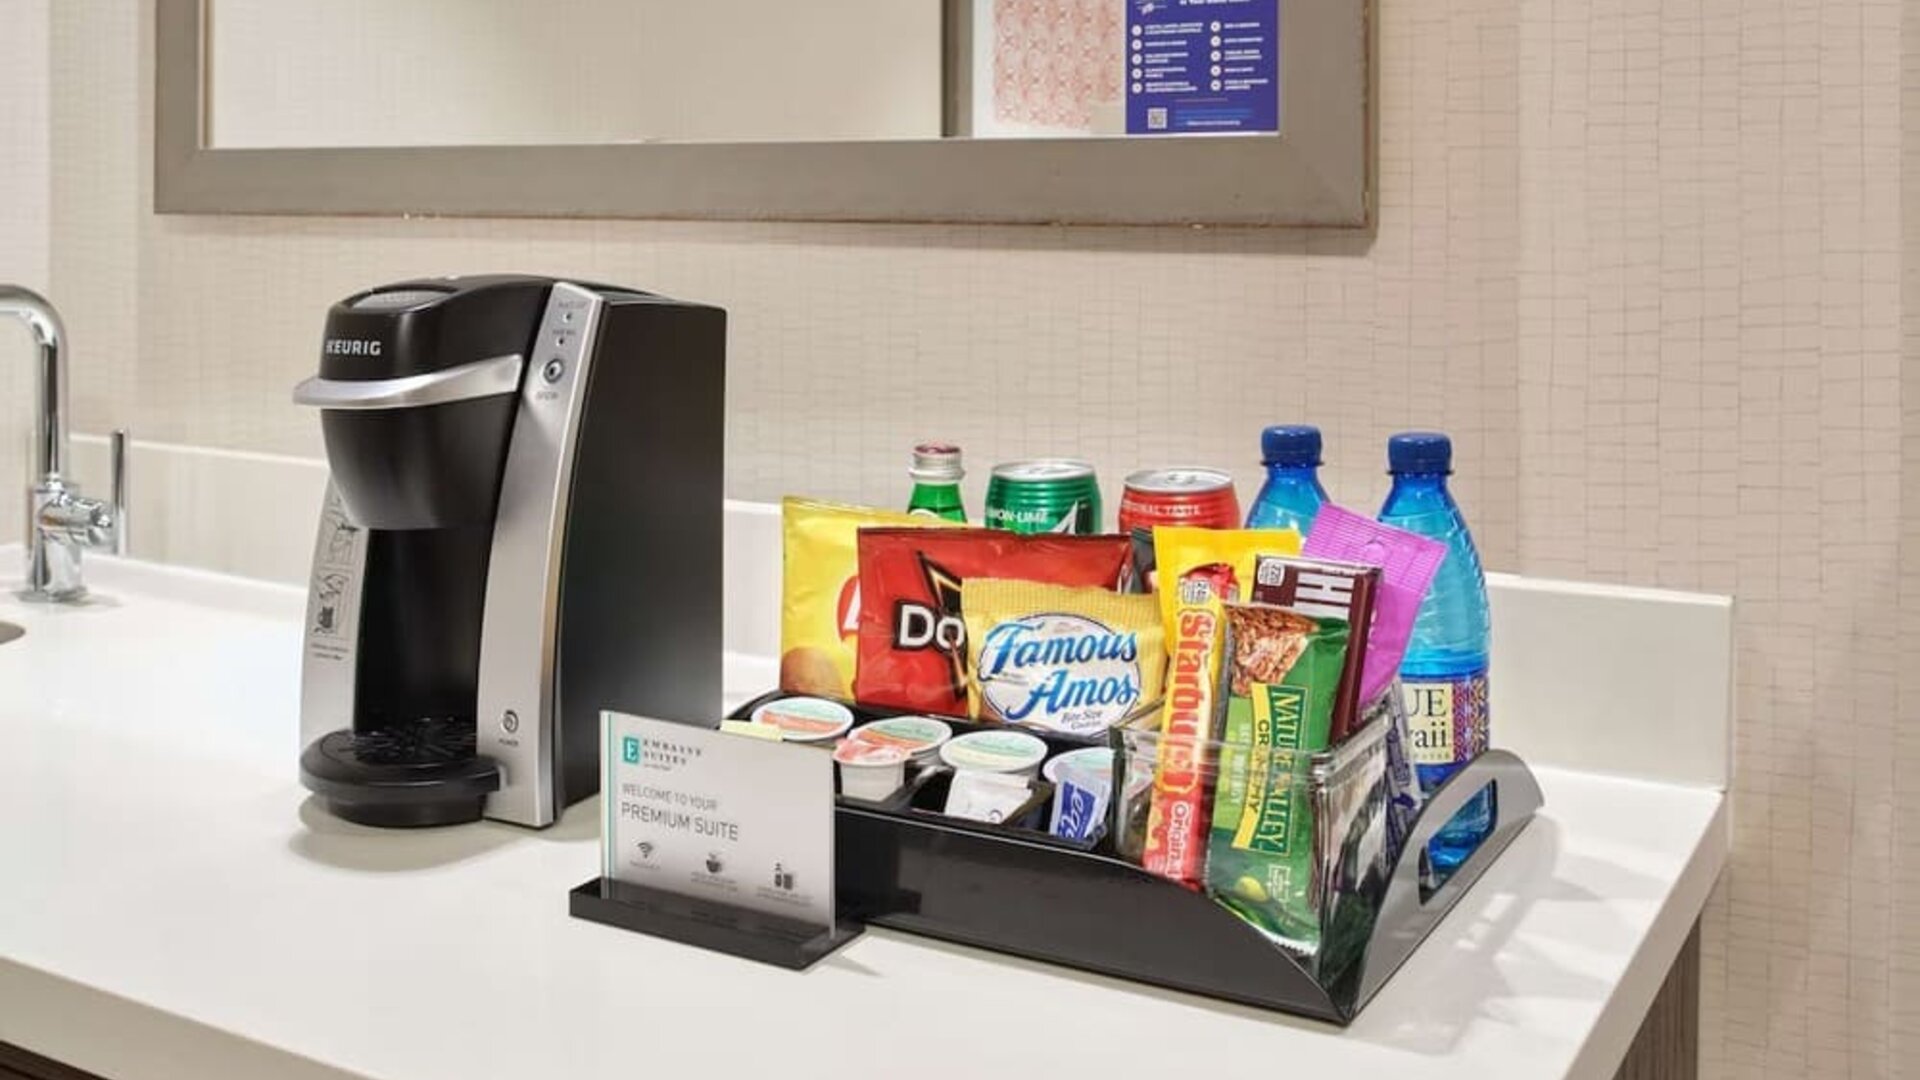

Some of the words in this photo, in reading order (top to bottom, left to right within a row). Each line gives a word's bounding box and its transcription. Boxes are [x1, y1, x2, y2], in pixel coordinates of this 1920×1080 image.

[325, 340, 382, 356] KEURIG
[984, 622, 1137, 675] Famous
[1005, 669, 1140, 720] Amos
[622, 783, 673, 804] WELCOME
[674, 792, 689, 806] TO
[690, 793, 717, 811] YOUR
[621, 802, 690, 831] PREMIUM
[695, 817, 738, 842] SUITE
